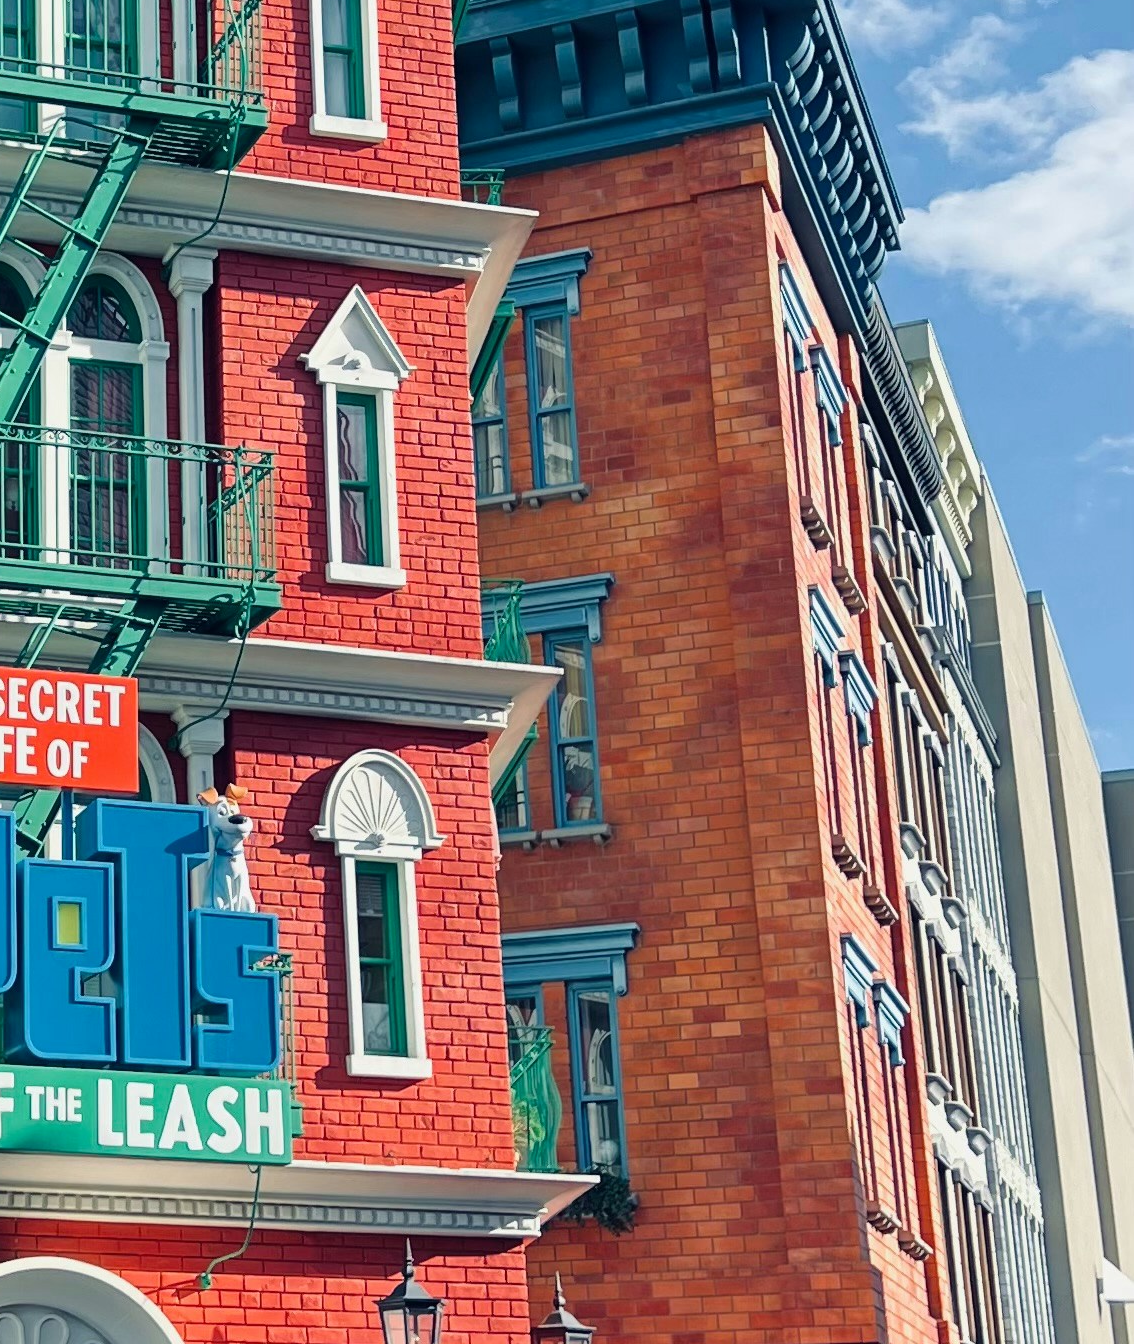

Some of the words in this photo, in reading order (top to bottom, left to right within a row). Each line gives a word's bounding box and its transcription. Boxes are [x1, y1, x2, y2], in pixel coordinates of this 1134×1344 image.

[46, 738, 90, 779] OF
[25, 1086, 82, 1123] THE
[97, 1078, 286, 1156] LEASH
